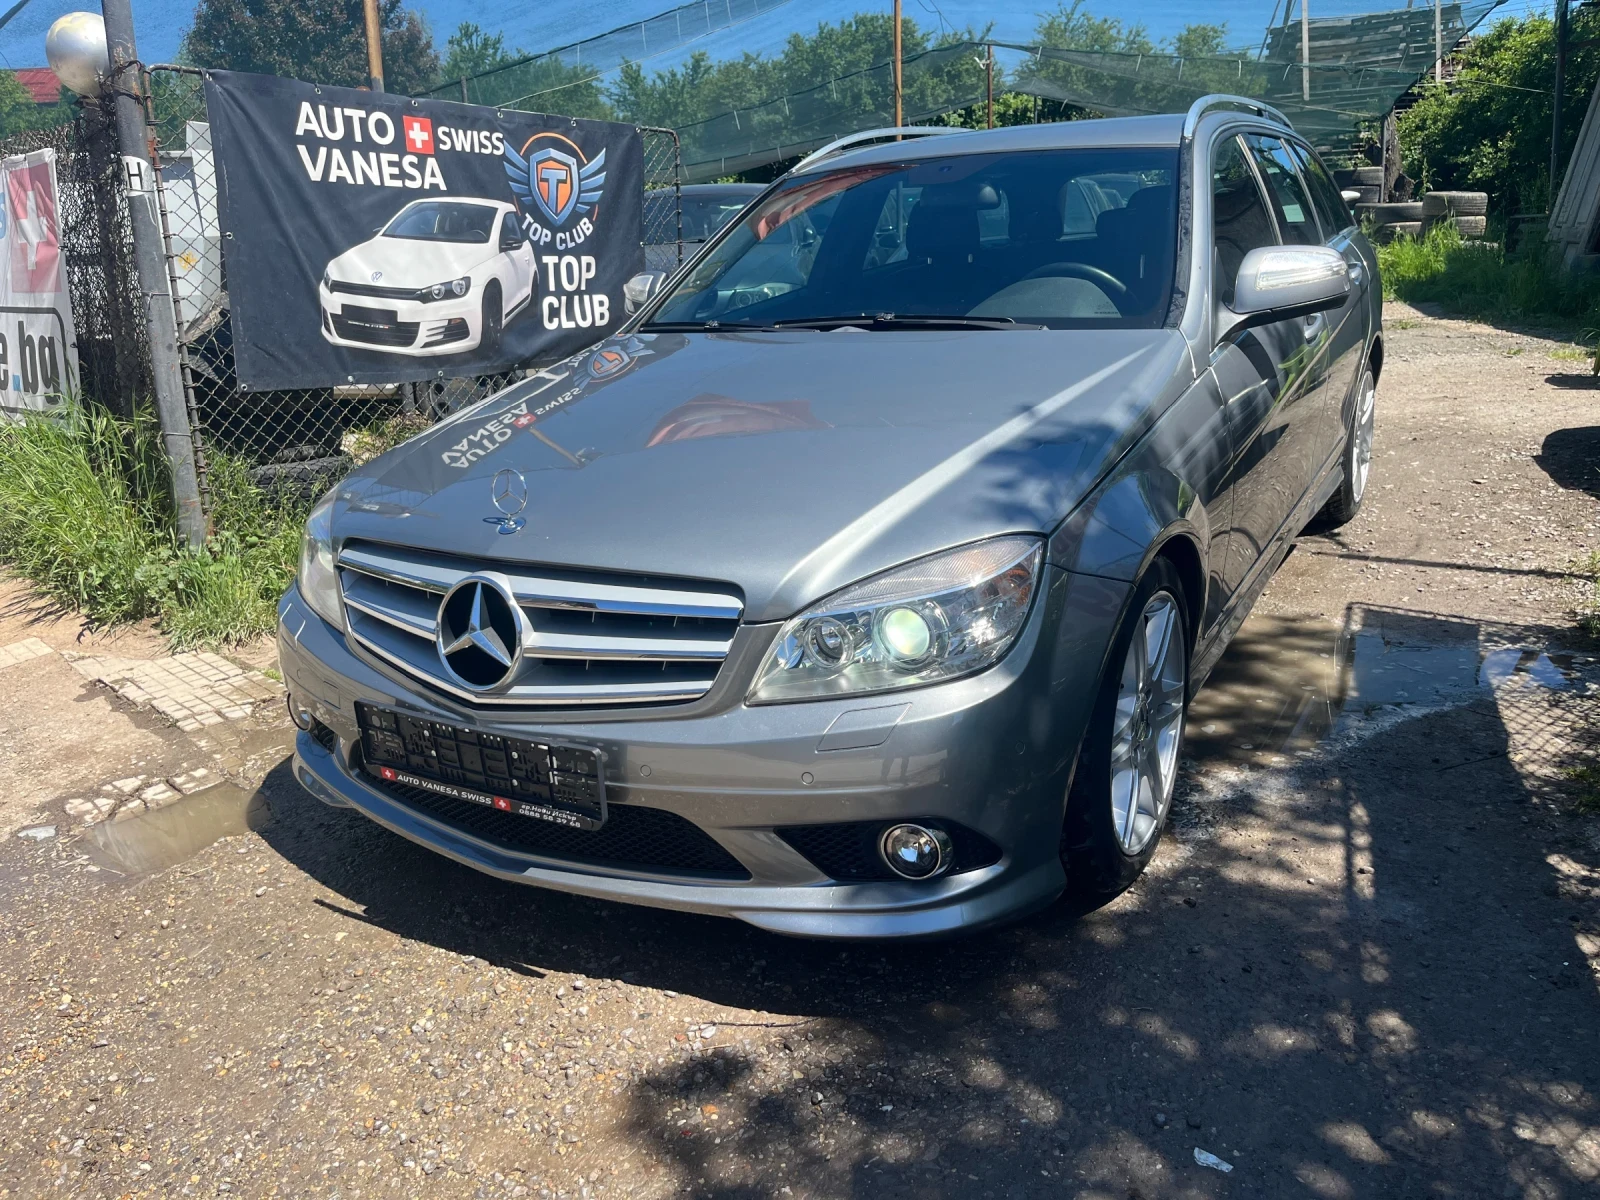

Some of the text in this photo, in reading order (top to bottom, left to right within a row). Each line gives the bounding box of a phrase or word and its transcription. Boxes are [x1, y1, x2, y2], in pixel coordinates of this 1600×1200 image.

[295, 101, 505, 156] AUTO SWISS
[296, 144, 447, 191] VANESA
[521, 212, 594, 250] TOP CLUB
[542, 255, 596, 292] TOP
[542, 294, 610, 330] CLUB
[397, 774, 492, 804] AUTO VANESA SWISS
